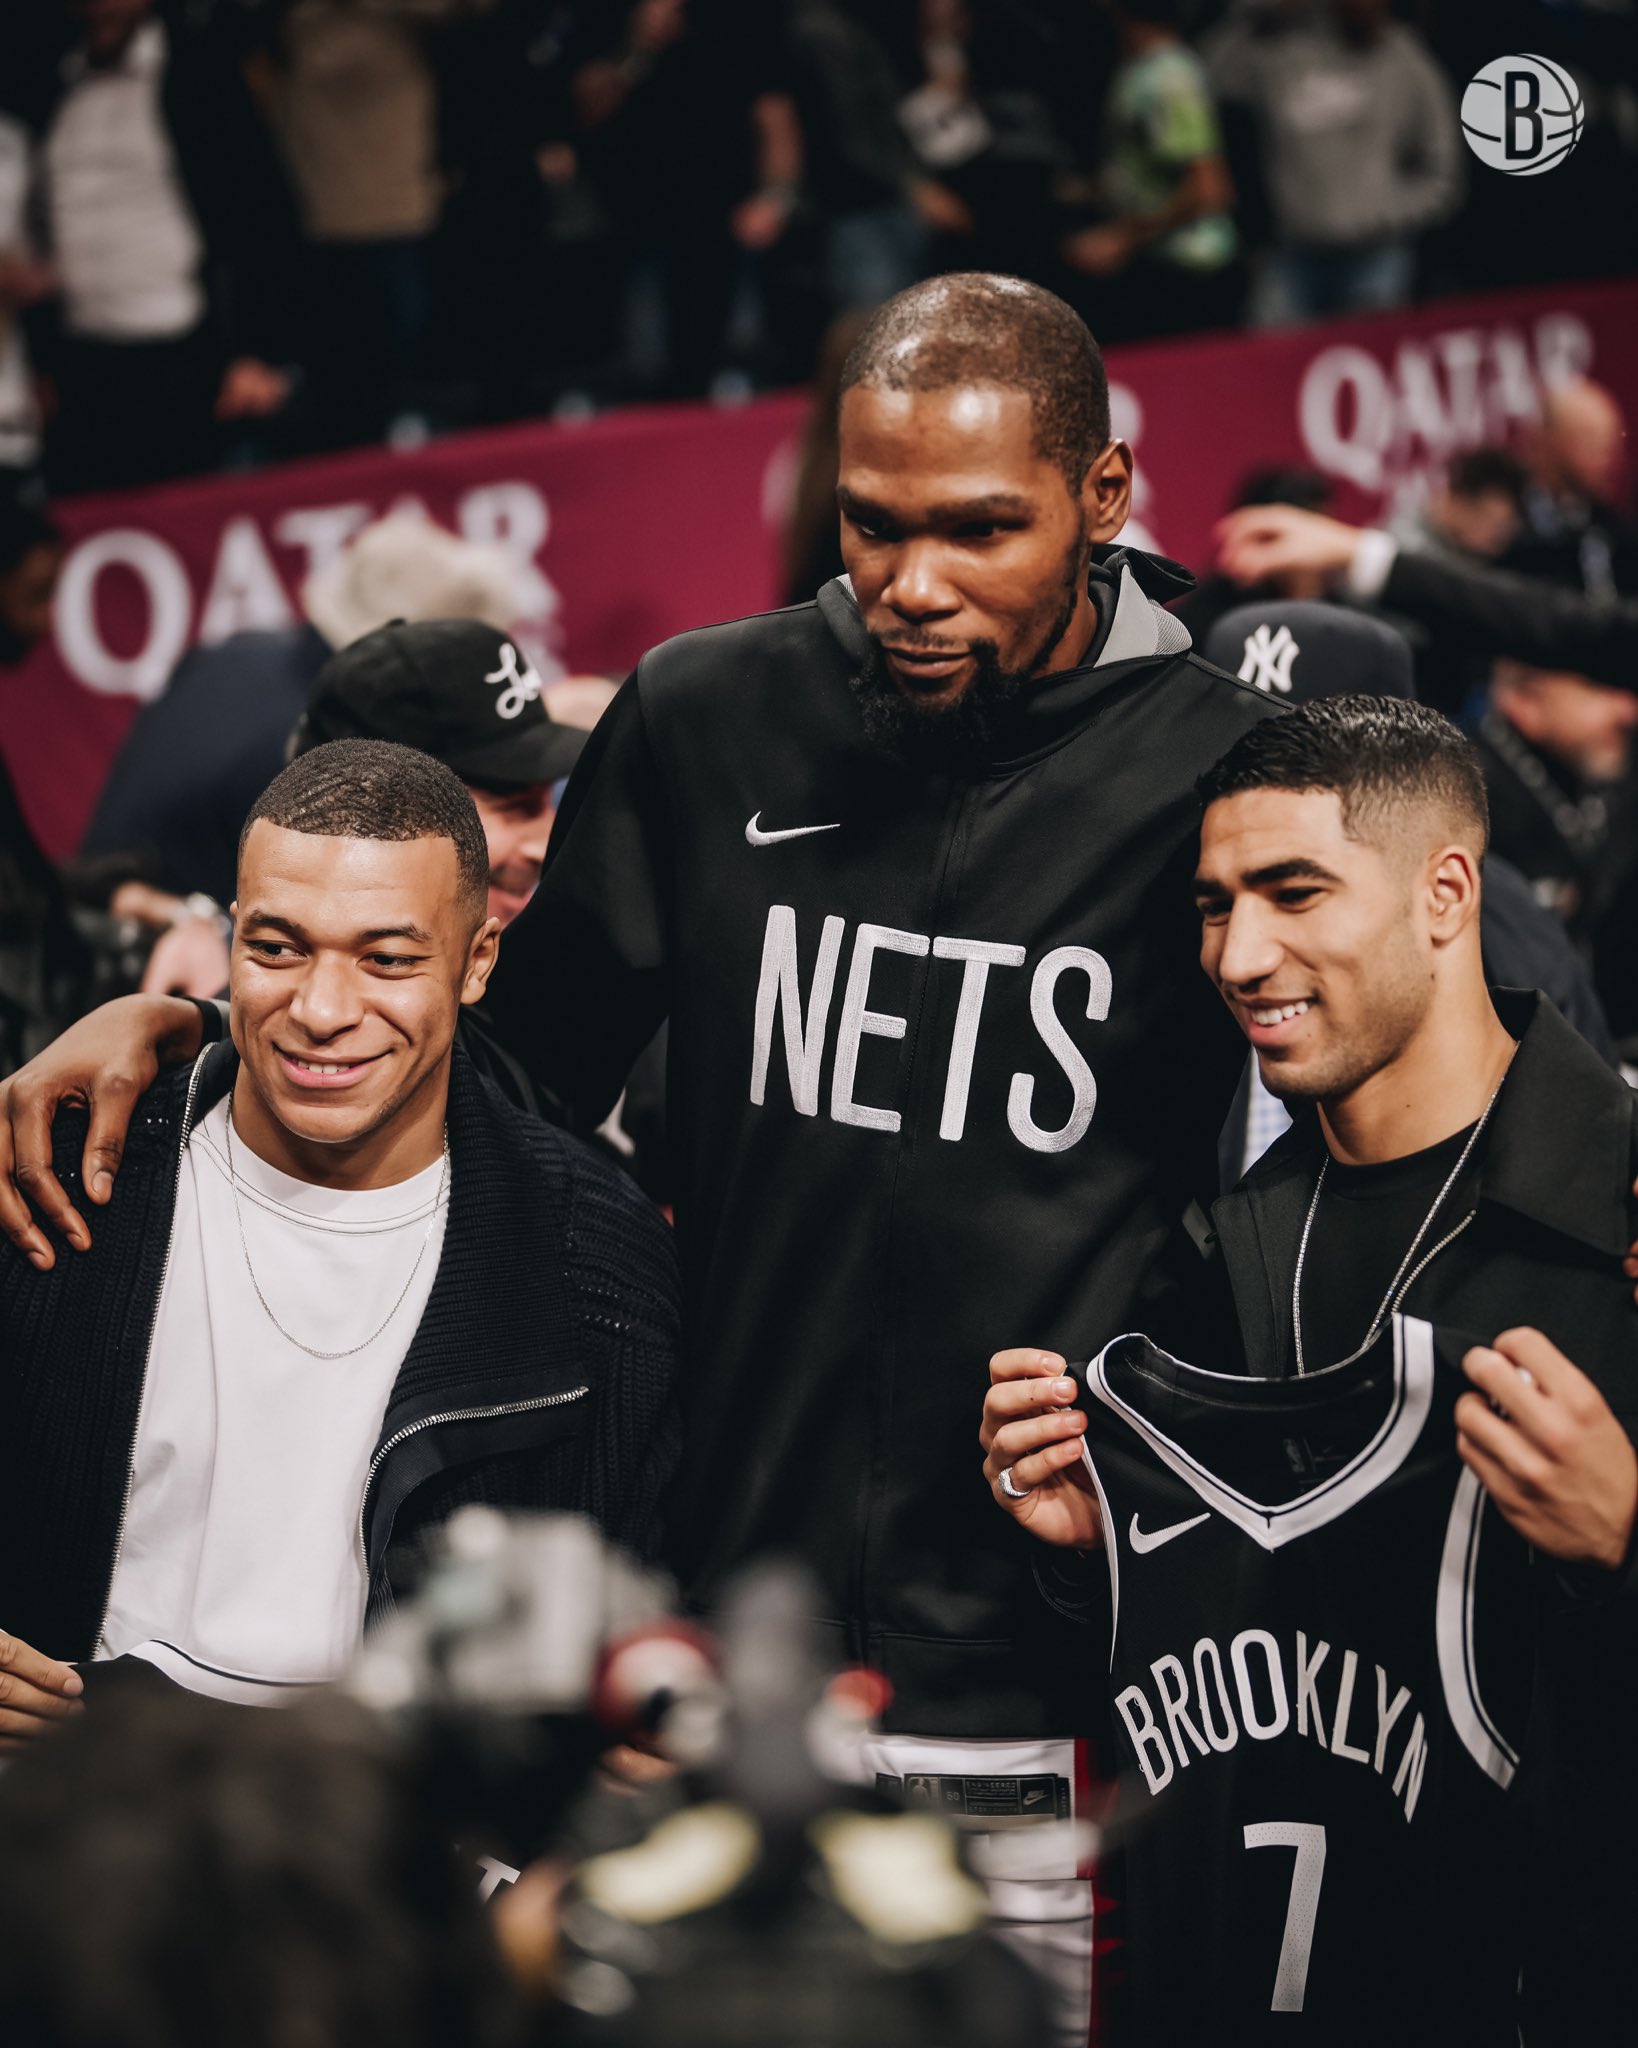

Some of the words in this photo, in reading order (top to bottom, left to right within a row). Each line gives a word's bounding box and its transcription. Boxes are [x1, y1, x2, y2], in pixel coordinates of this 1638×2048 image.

[51, 480, 560, 700] QATR
[1237, 623, 1301, 693] NY
[750, 904, 1113, 1153] NETS
[1114, 1628, 1428, 1824] BROOKLYN
[1243, 1821, 1327, 2012] 7
